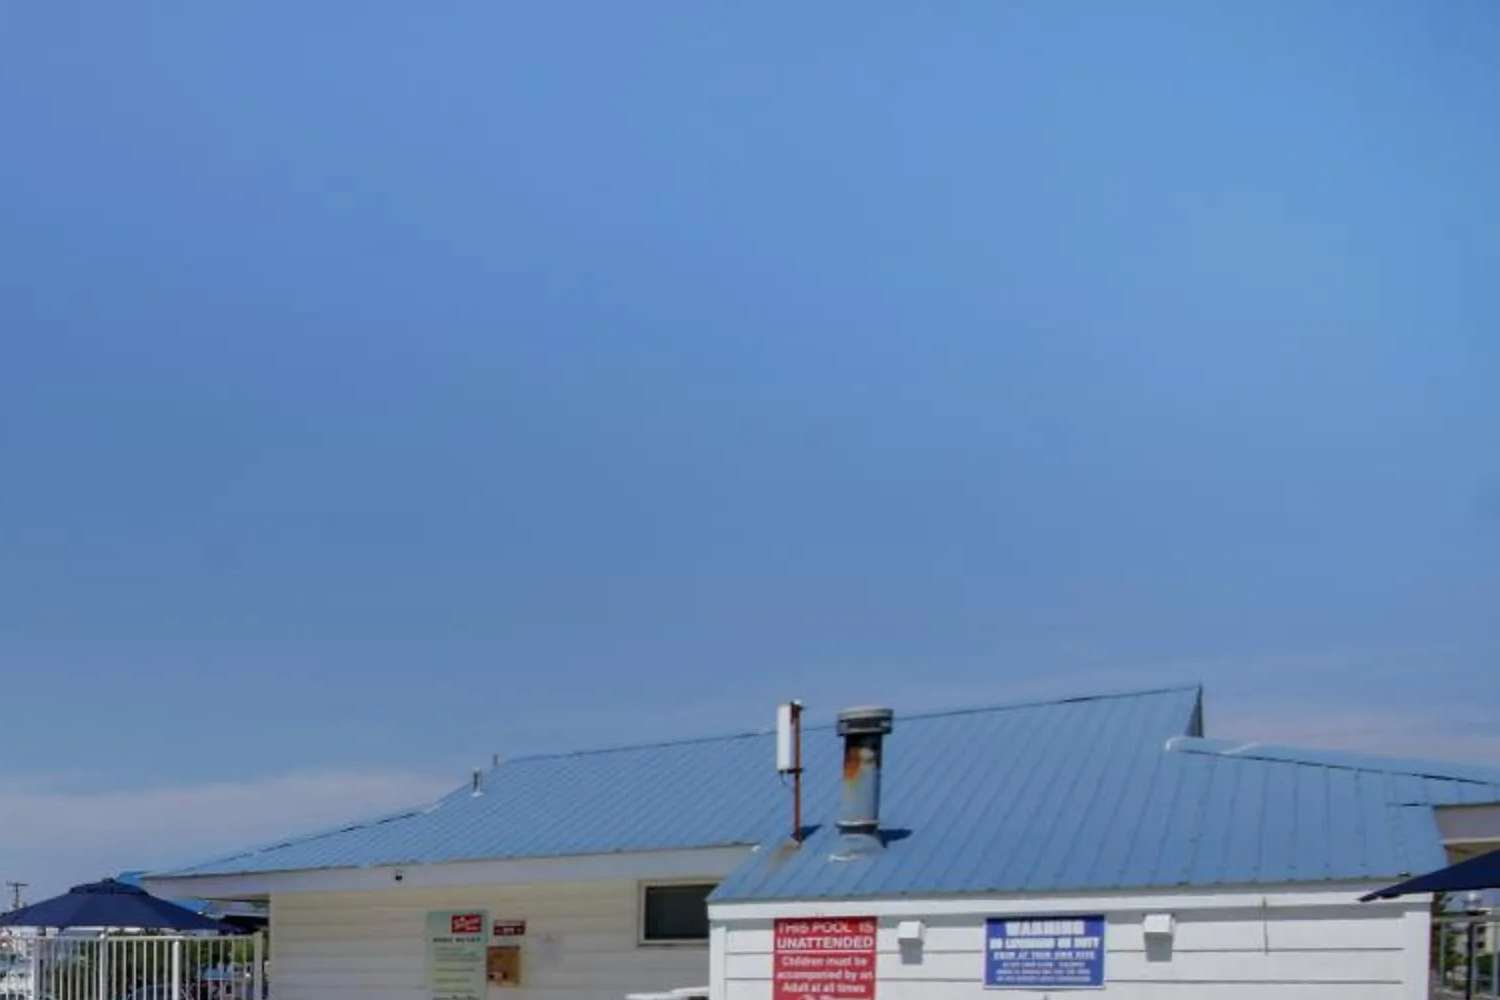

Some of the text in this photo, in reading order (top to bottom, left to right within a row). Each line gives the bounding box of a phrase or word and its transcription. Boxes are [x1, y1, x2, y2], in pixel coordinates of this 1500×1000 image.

[780, 921, 874, 934] THIS POOL IS
[777, 935, 873, 949] UNATTENDED
